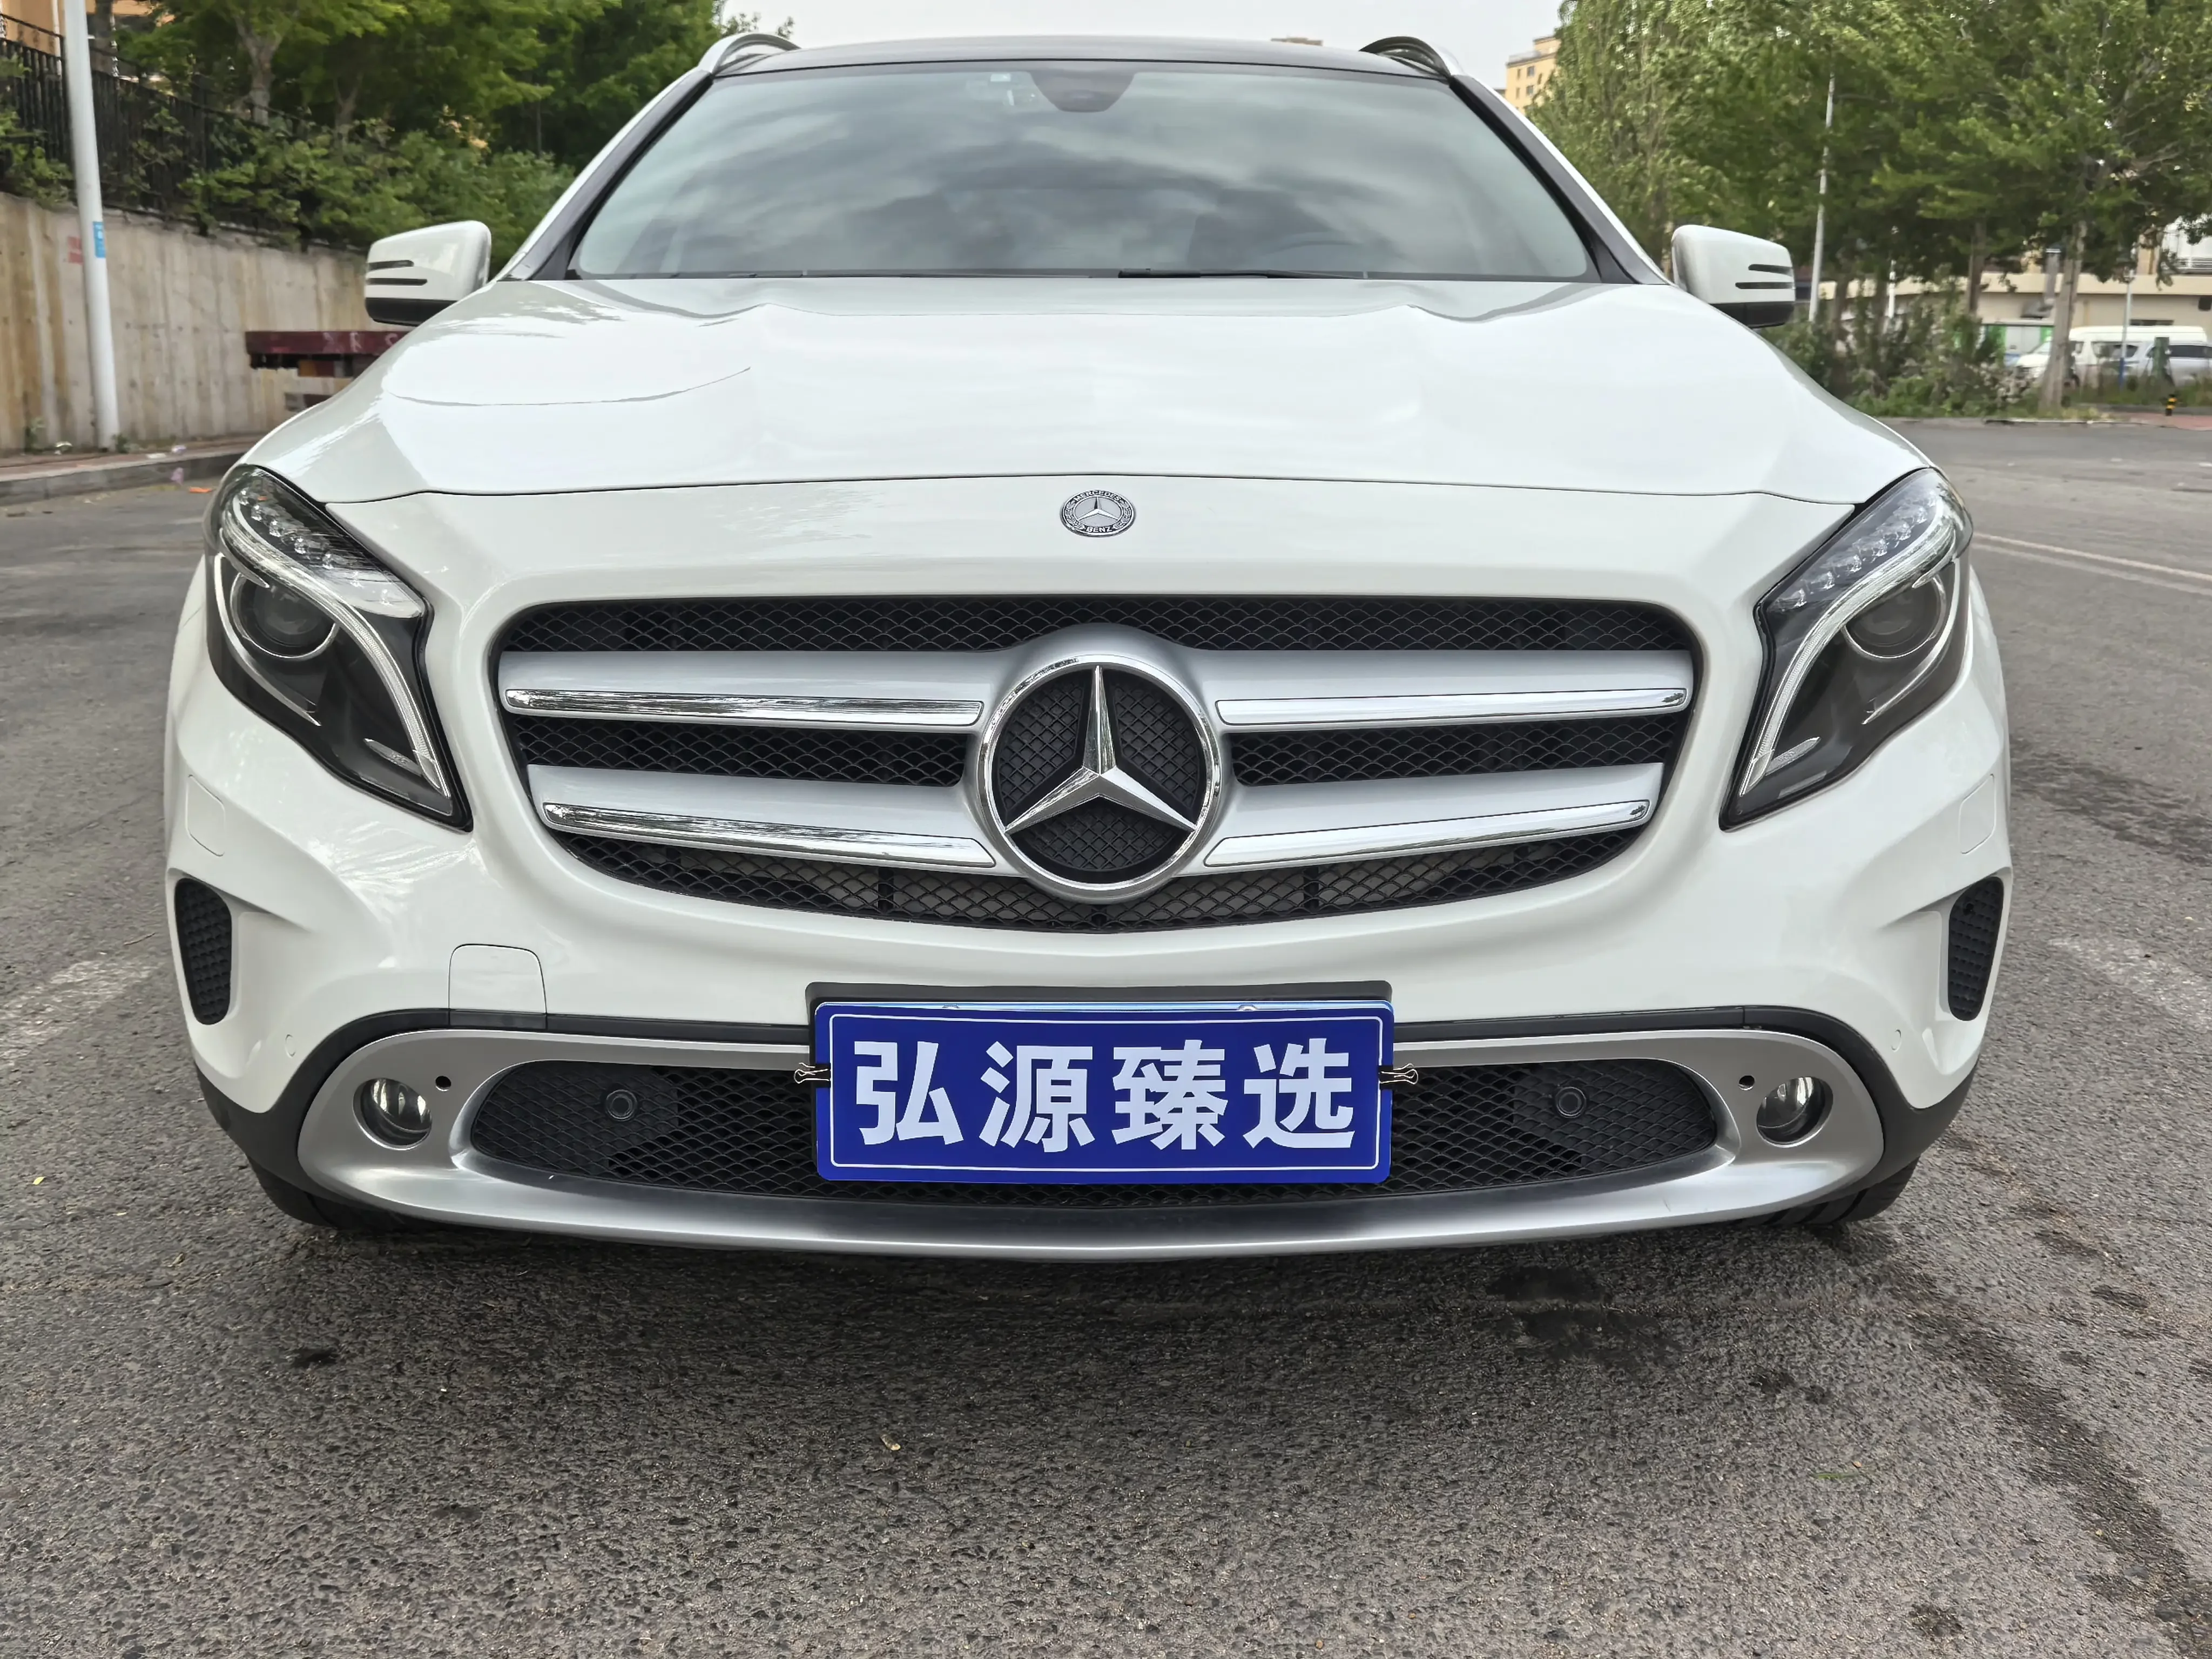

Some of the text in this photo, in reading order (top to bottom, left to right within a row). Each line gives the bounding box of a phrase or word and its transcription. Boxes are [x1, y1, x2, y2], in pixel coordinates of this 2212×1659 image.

[1073, 490, 1122, 502] MERCEDES
[854, 1038, 1355, 1152] 弘源臻选
